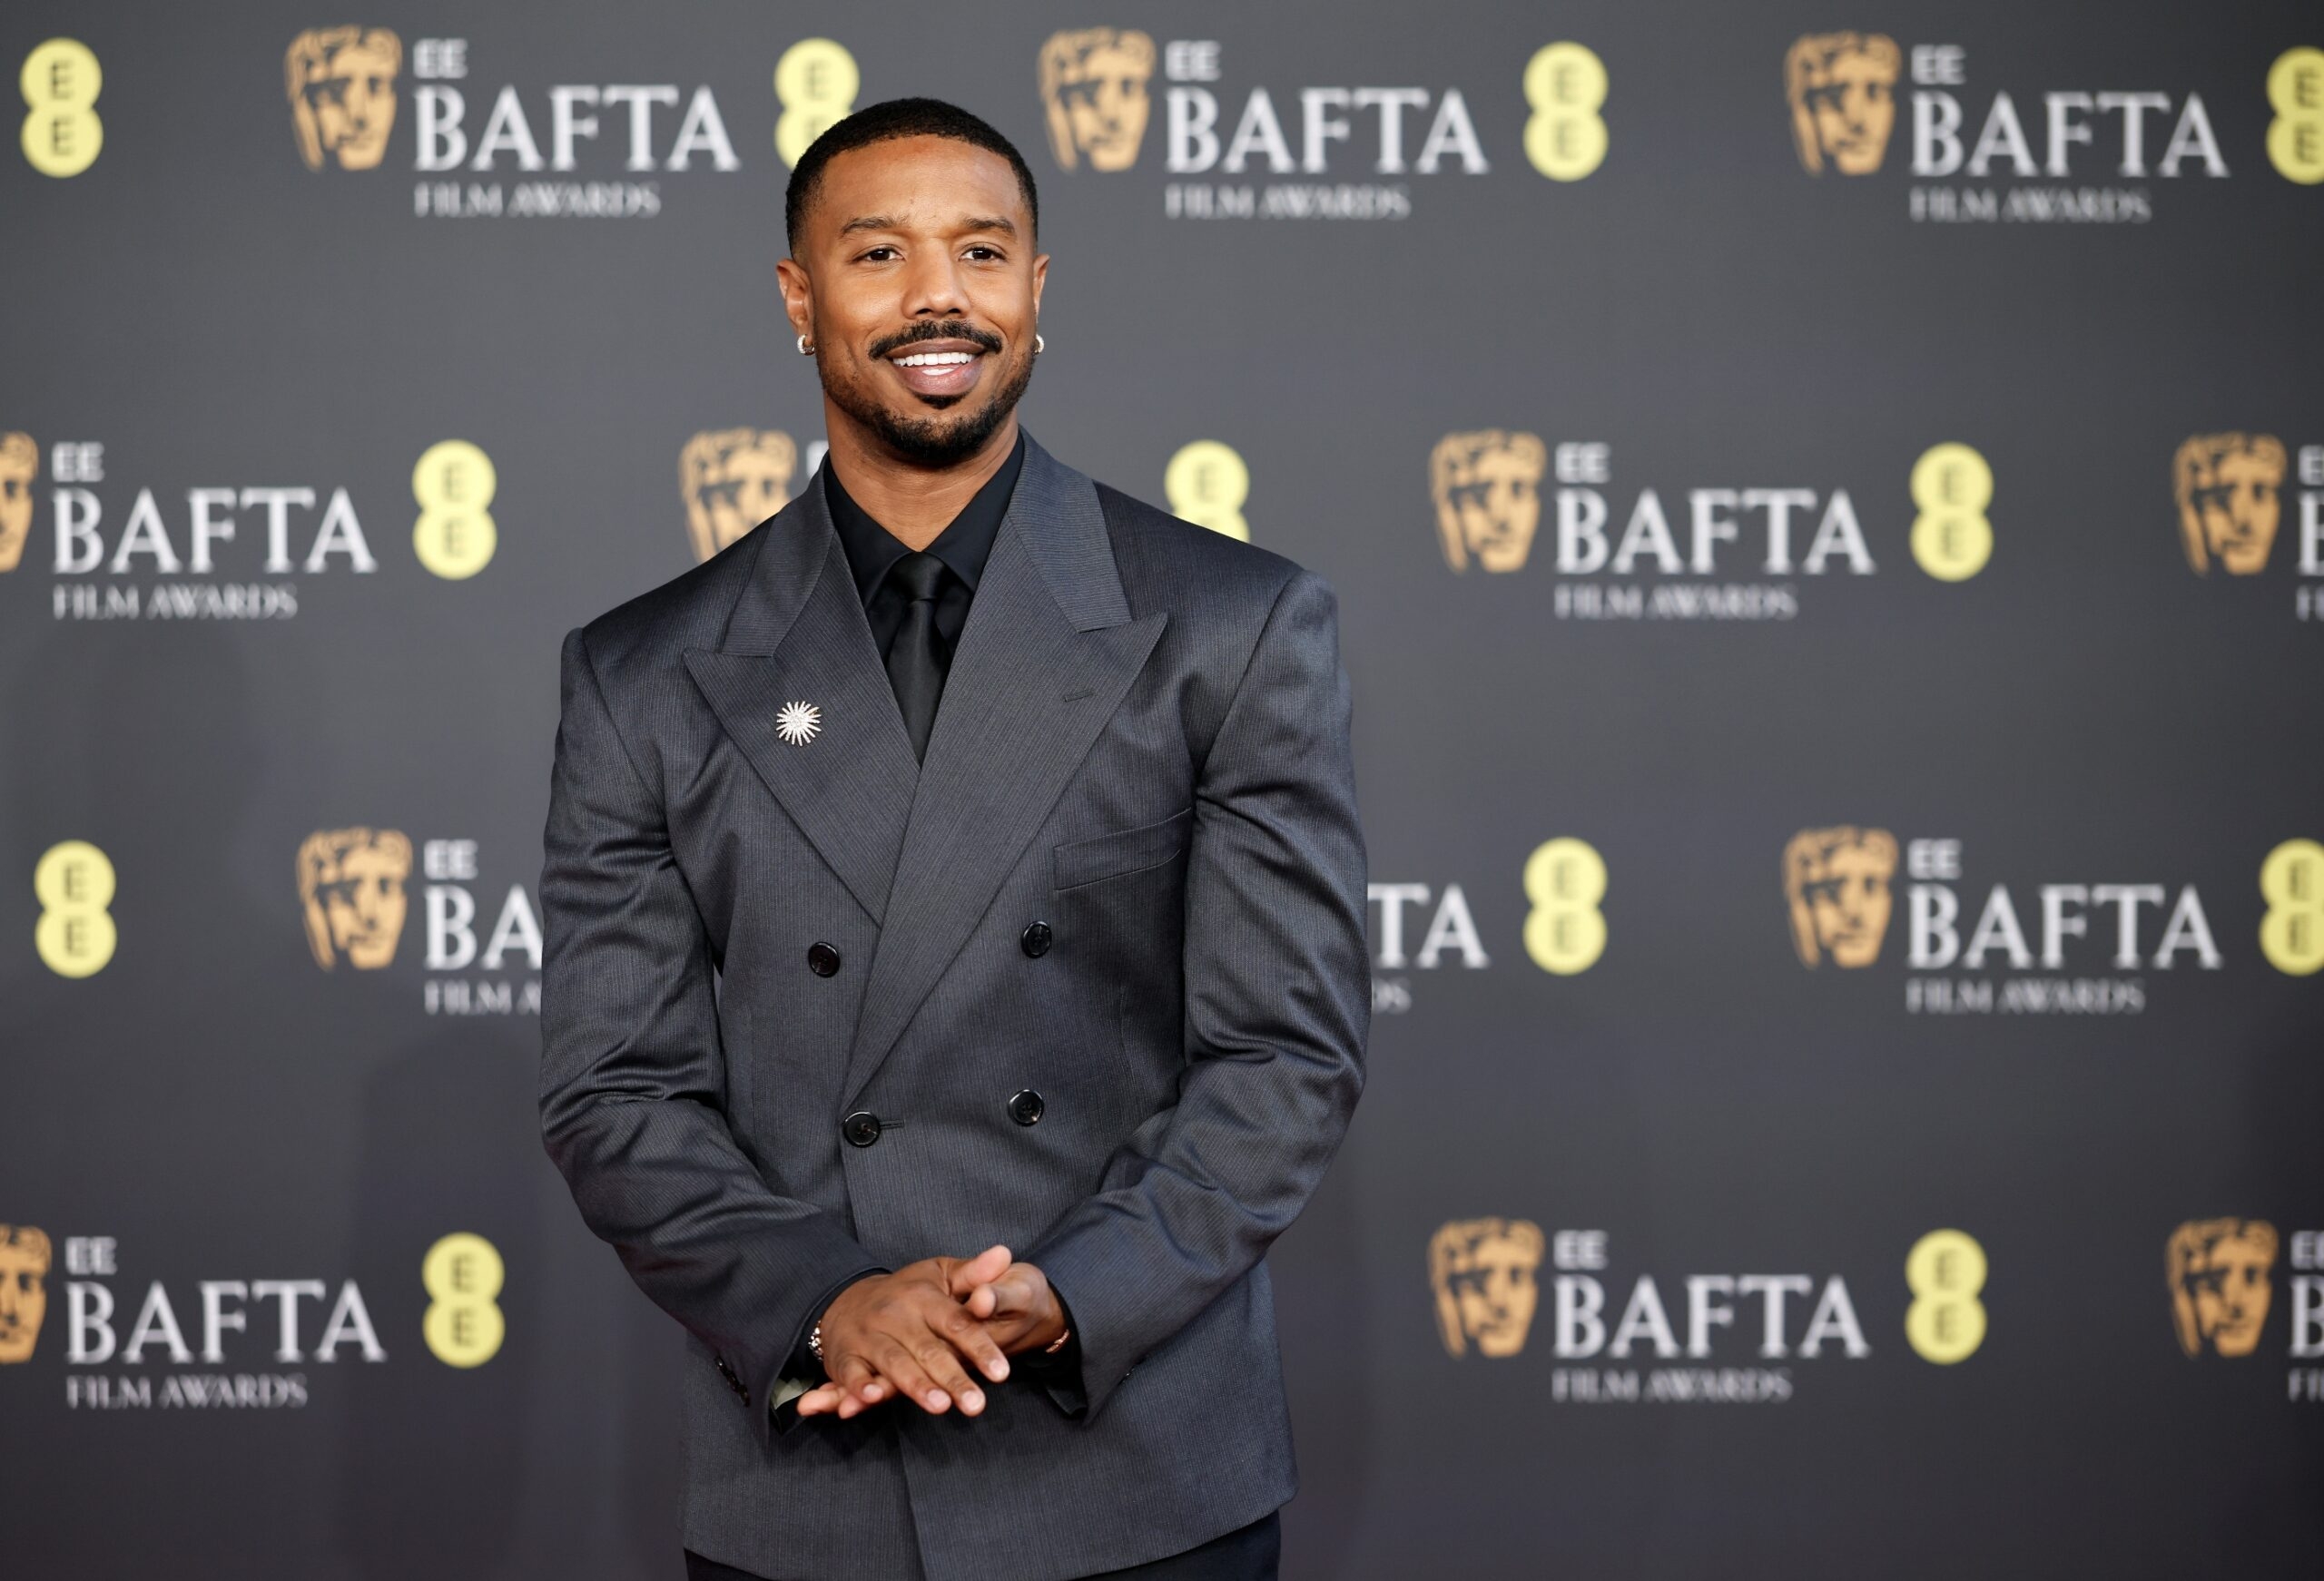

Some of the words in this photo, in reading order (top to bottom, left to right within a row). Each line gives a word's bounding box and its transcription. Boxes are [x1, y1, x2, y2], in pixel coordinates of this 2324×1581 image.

[413, 39, 468, 79] EE
[1166, 41, 1219, 81] EE
[1911, 44, 1965, 84] EE
[415, 84, 740, 172] BAFTA
[1167, 87, 1488, 174] BAFTA
[1911, 91, 2228, 177] BAFTA
[414, 182, 503, 217] FILM
[510, 183, 661, 216] AWARDS
[1166, 184, 1255, 219] FILM
[1260, 185, 1410, 219] AWARDS
[1910, 187, 1997, 221] FILM
[2003, 189, 2151, 221] AWARDS
[52, 442, 103, 482] EE
[1555, 442, 1609, 483] EE
[54, 486, 377, 574] BAFTA
[1556, 488, 1874, 574] BAFTA
[53, 584, 139, 619] FILM
[149, 584, 298, 618] AWARDS
[1554, 584, 1643, 619] FILM
[1648, 584, 1797, 618] AWARDS
[424, 840, 477, 879] EE
[1908, 839, 1960, 879] EE
[1907, 883, 2221, 969] BAFTA
[425, 980, 512, 1014] FILM
[1906, 978, 1993, 1013] FILM
[1999, 979, 2144, 1012] AWARDS
[65, 1236, 116, 1274] EE
[1554, 1230, 1606, 1270] EE
[67, 1280, 385, 1363] BAFTA
[1554, 1274, 1868, 1358] BAFTA
[66, 1376, 152, 1409] FILM
[160, 1374, 308, 1408] AWARDS
[1552, 1369, 1640, 1401] FILM
[1646, 1369, 1791, 1400] AWARDS
